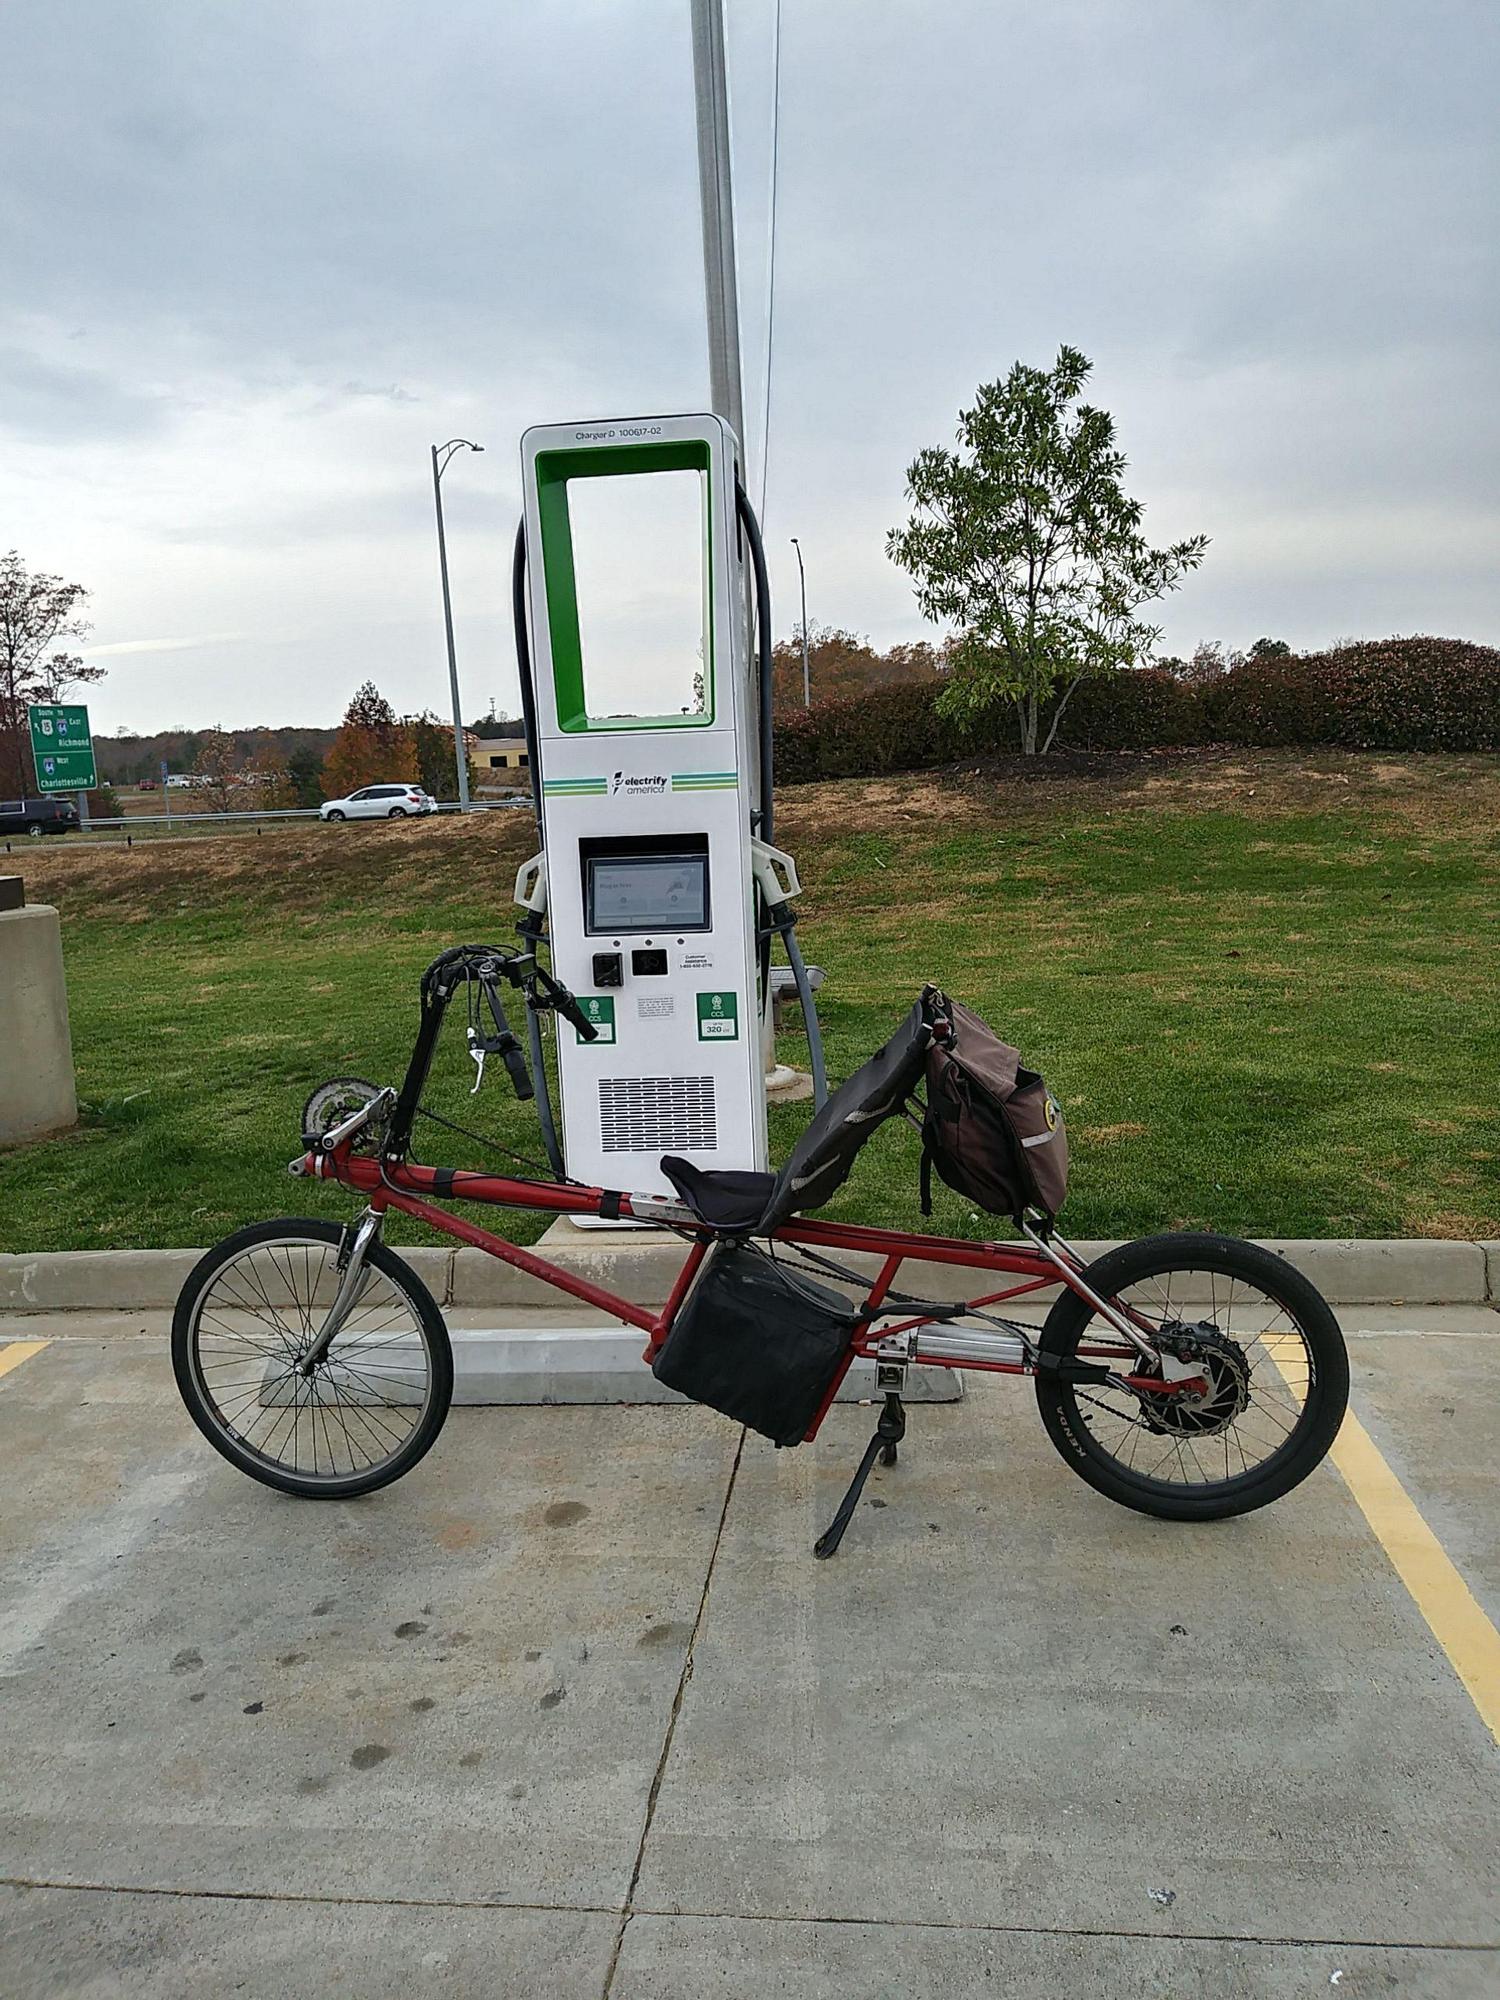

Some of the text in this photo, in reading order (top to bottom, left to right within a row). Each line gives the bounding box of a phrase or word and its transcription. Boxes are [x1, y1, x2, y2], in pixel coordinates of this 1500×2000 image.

[575, 431, 607, 440] Charger
[58, 738, 89, 747] Richmond
[41, 777, 87, 787] Charlottesville
[625, 776, 668, 786] electrify
[627, 786, 665, 795] america
[1056, 1405, 1087, 1457] KENDA
